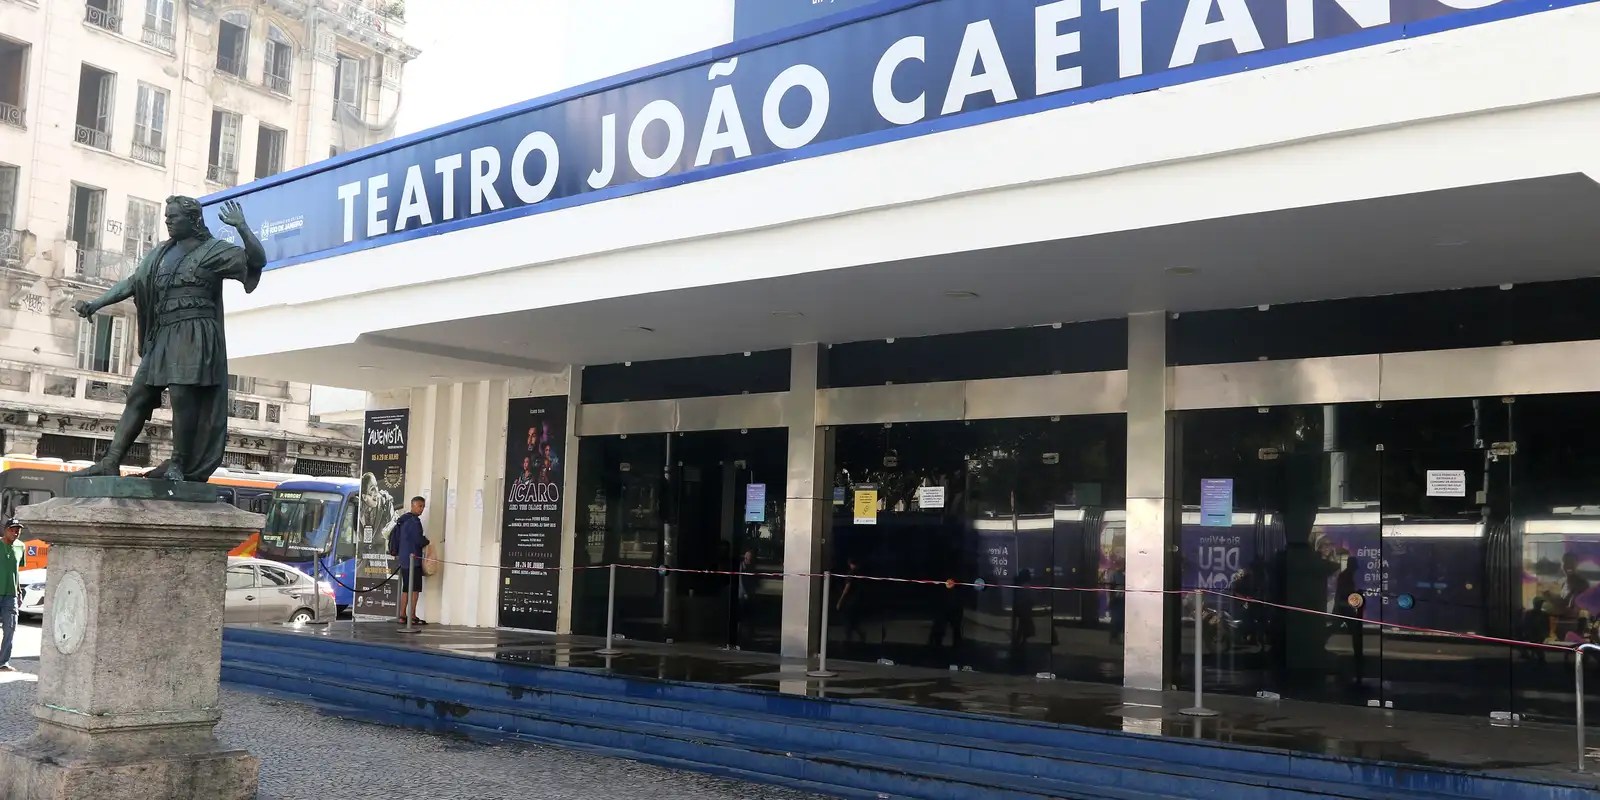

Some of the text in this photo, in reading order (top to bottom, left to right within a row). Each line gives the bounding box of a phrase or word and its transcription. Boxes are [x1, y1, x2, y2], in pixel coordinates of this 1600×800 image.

[338, 0, 1497, 242] TEATRO JOÃO CAETA
[368, 424, 404, 445] ALIENISTA
